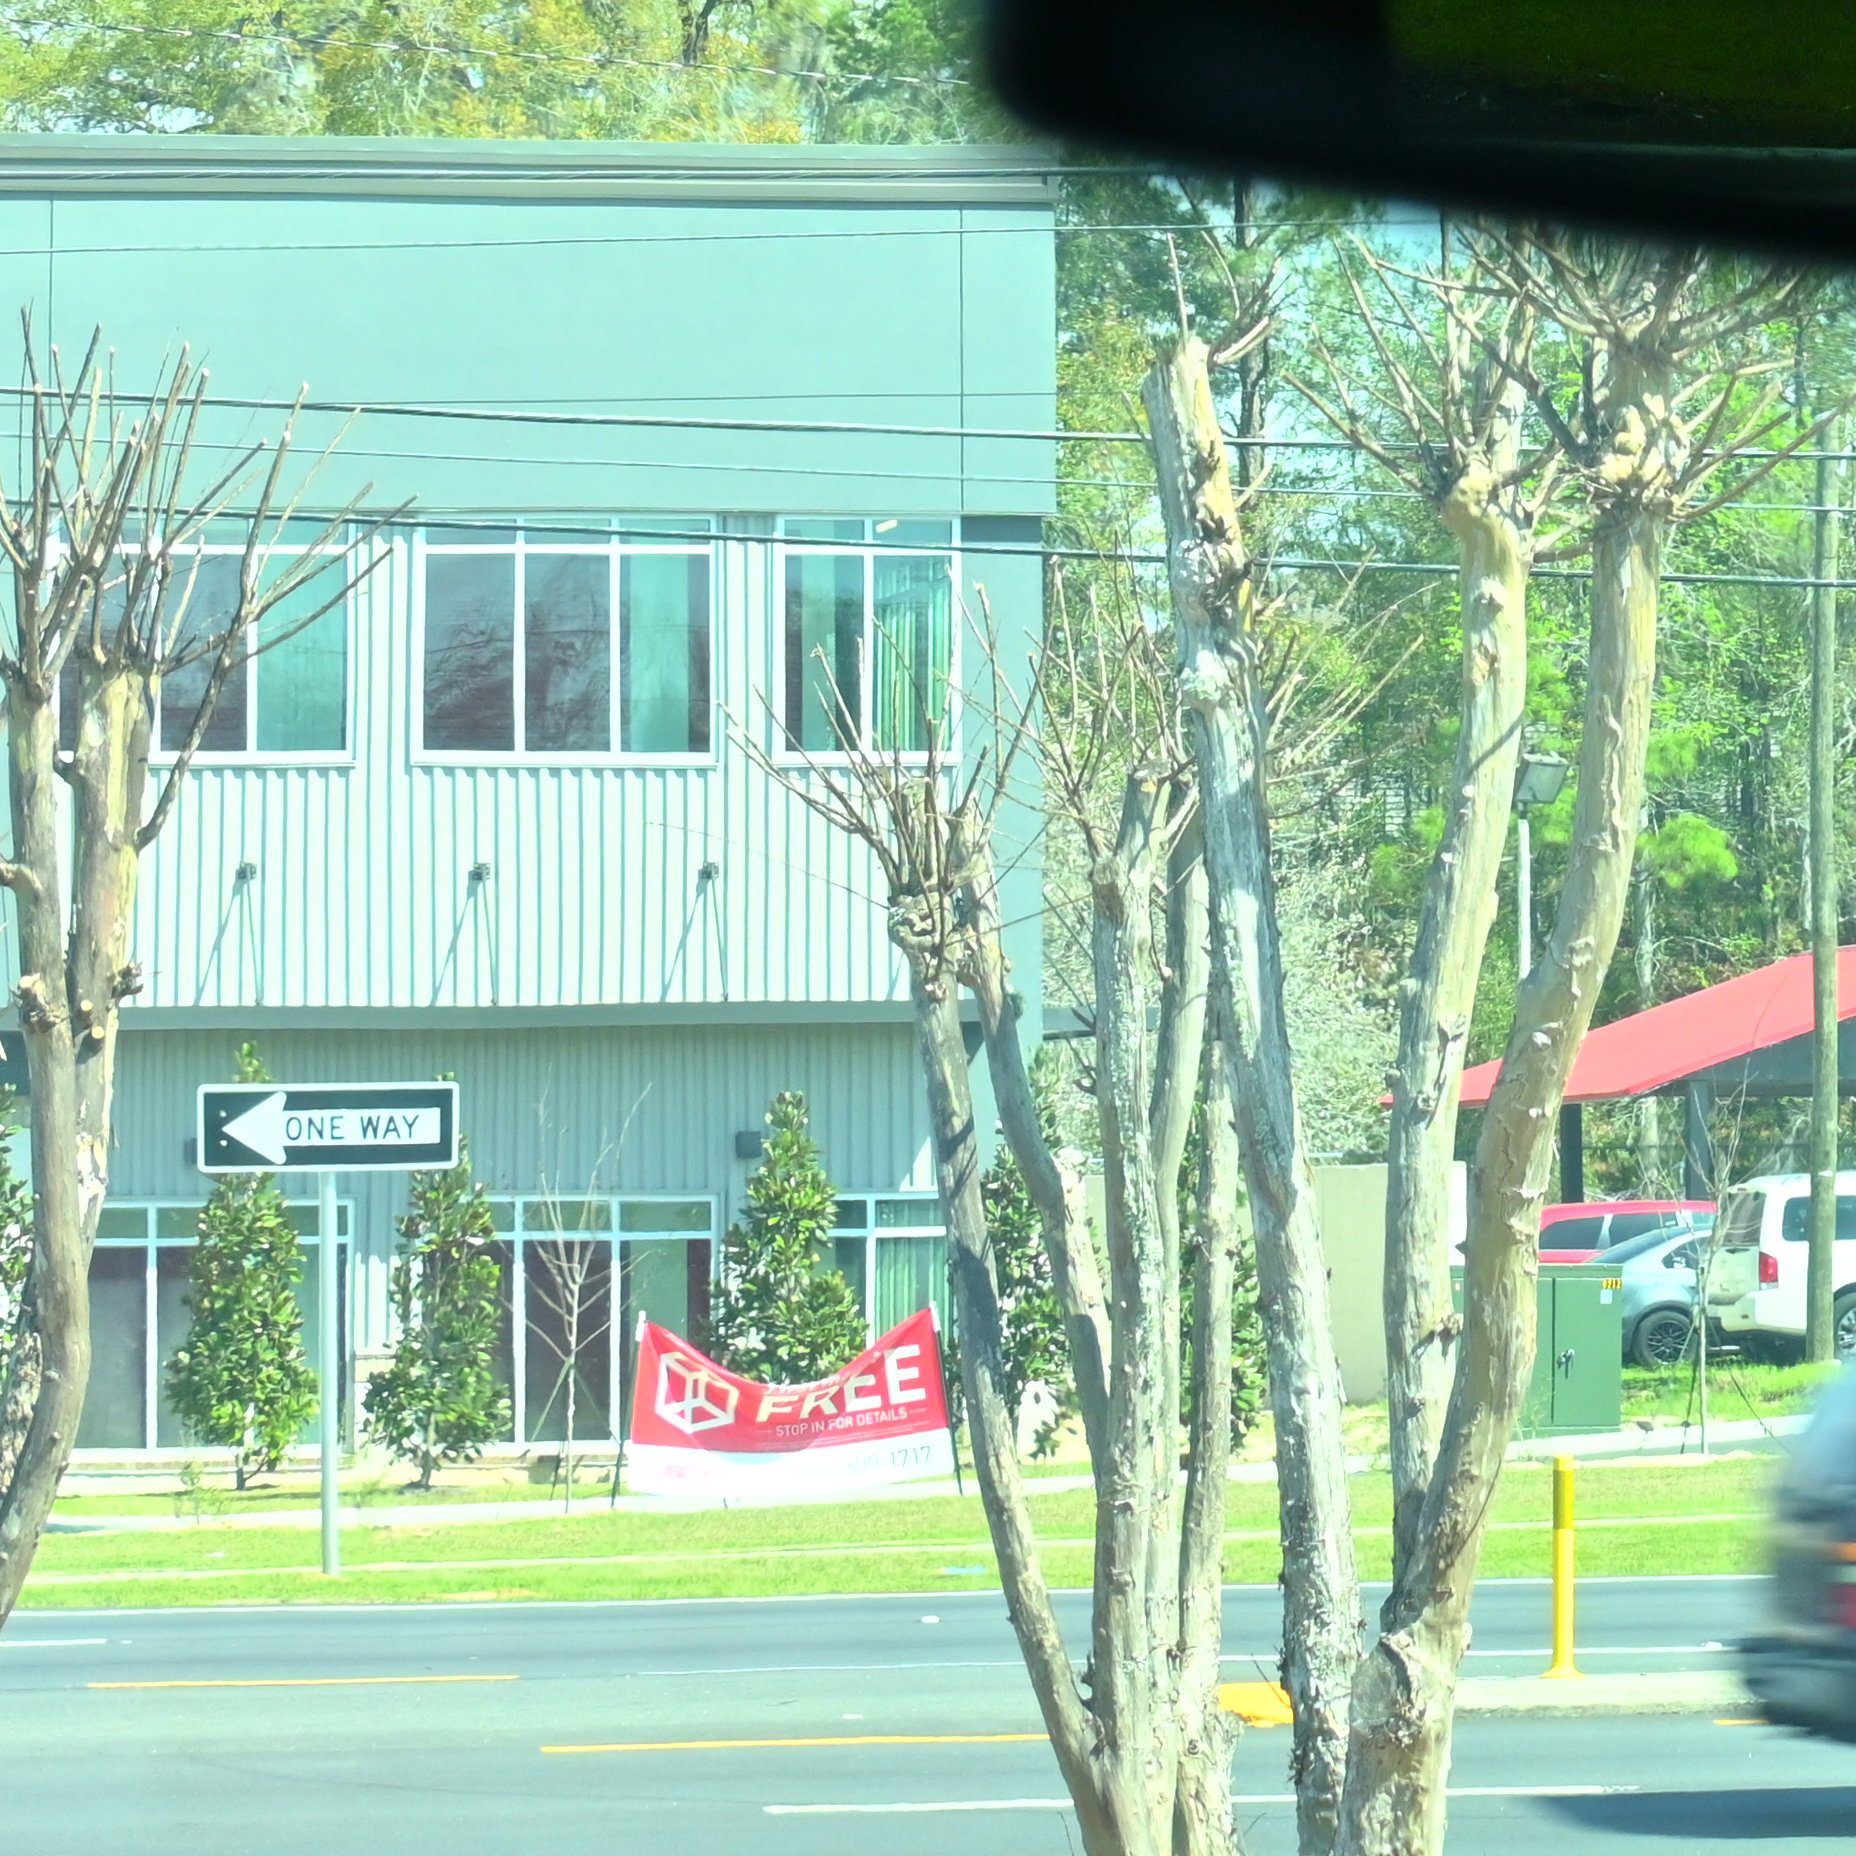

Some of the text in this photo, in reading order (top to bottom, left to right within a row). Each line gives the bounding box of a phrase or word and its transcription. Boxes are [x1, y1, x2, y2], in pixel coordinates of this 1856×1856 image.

[285, 1114, 420, 1141] ONE WAY
[755, 1344, 927, 1423] FREE
[775, 1406, 908, 1437] STOP IN FOR DETAILS
[890, 1445, 931, 1468] 1717
